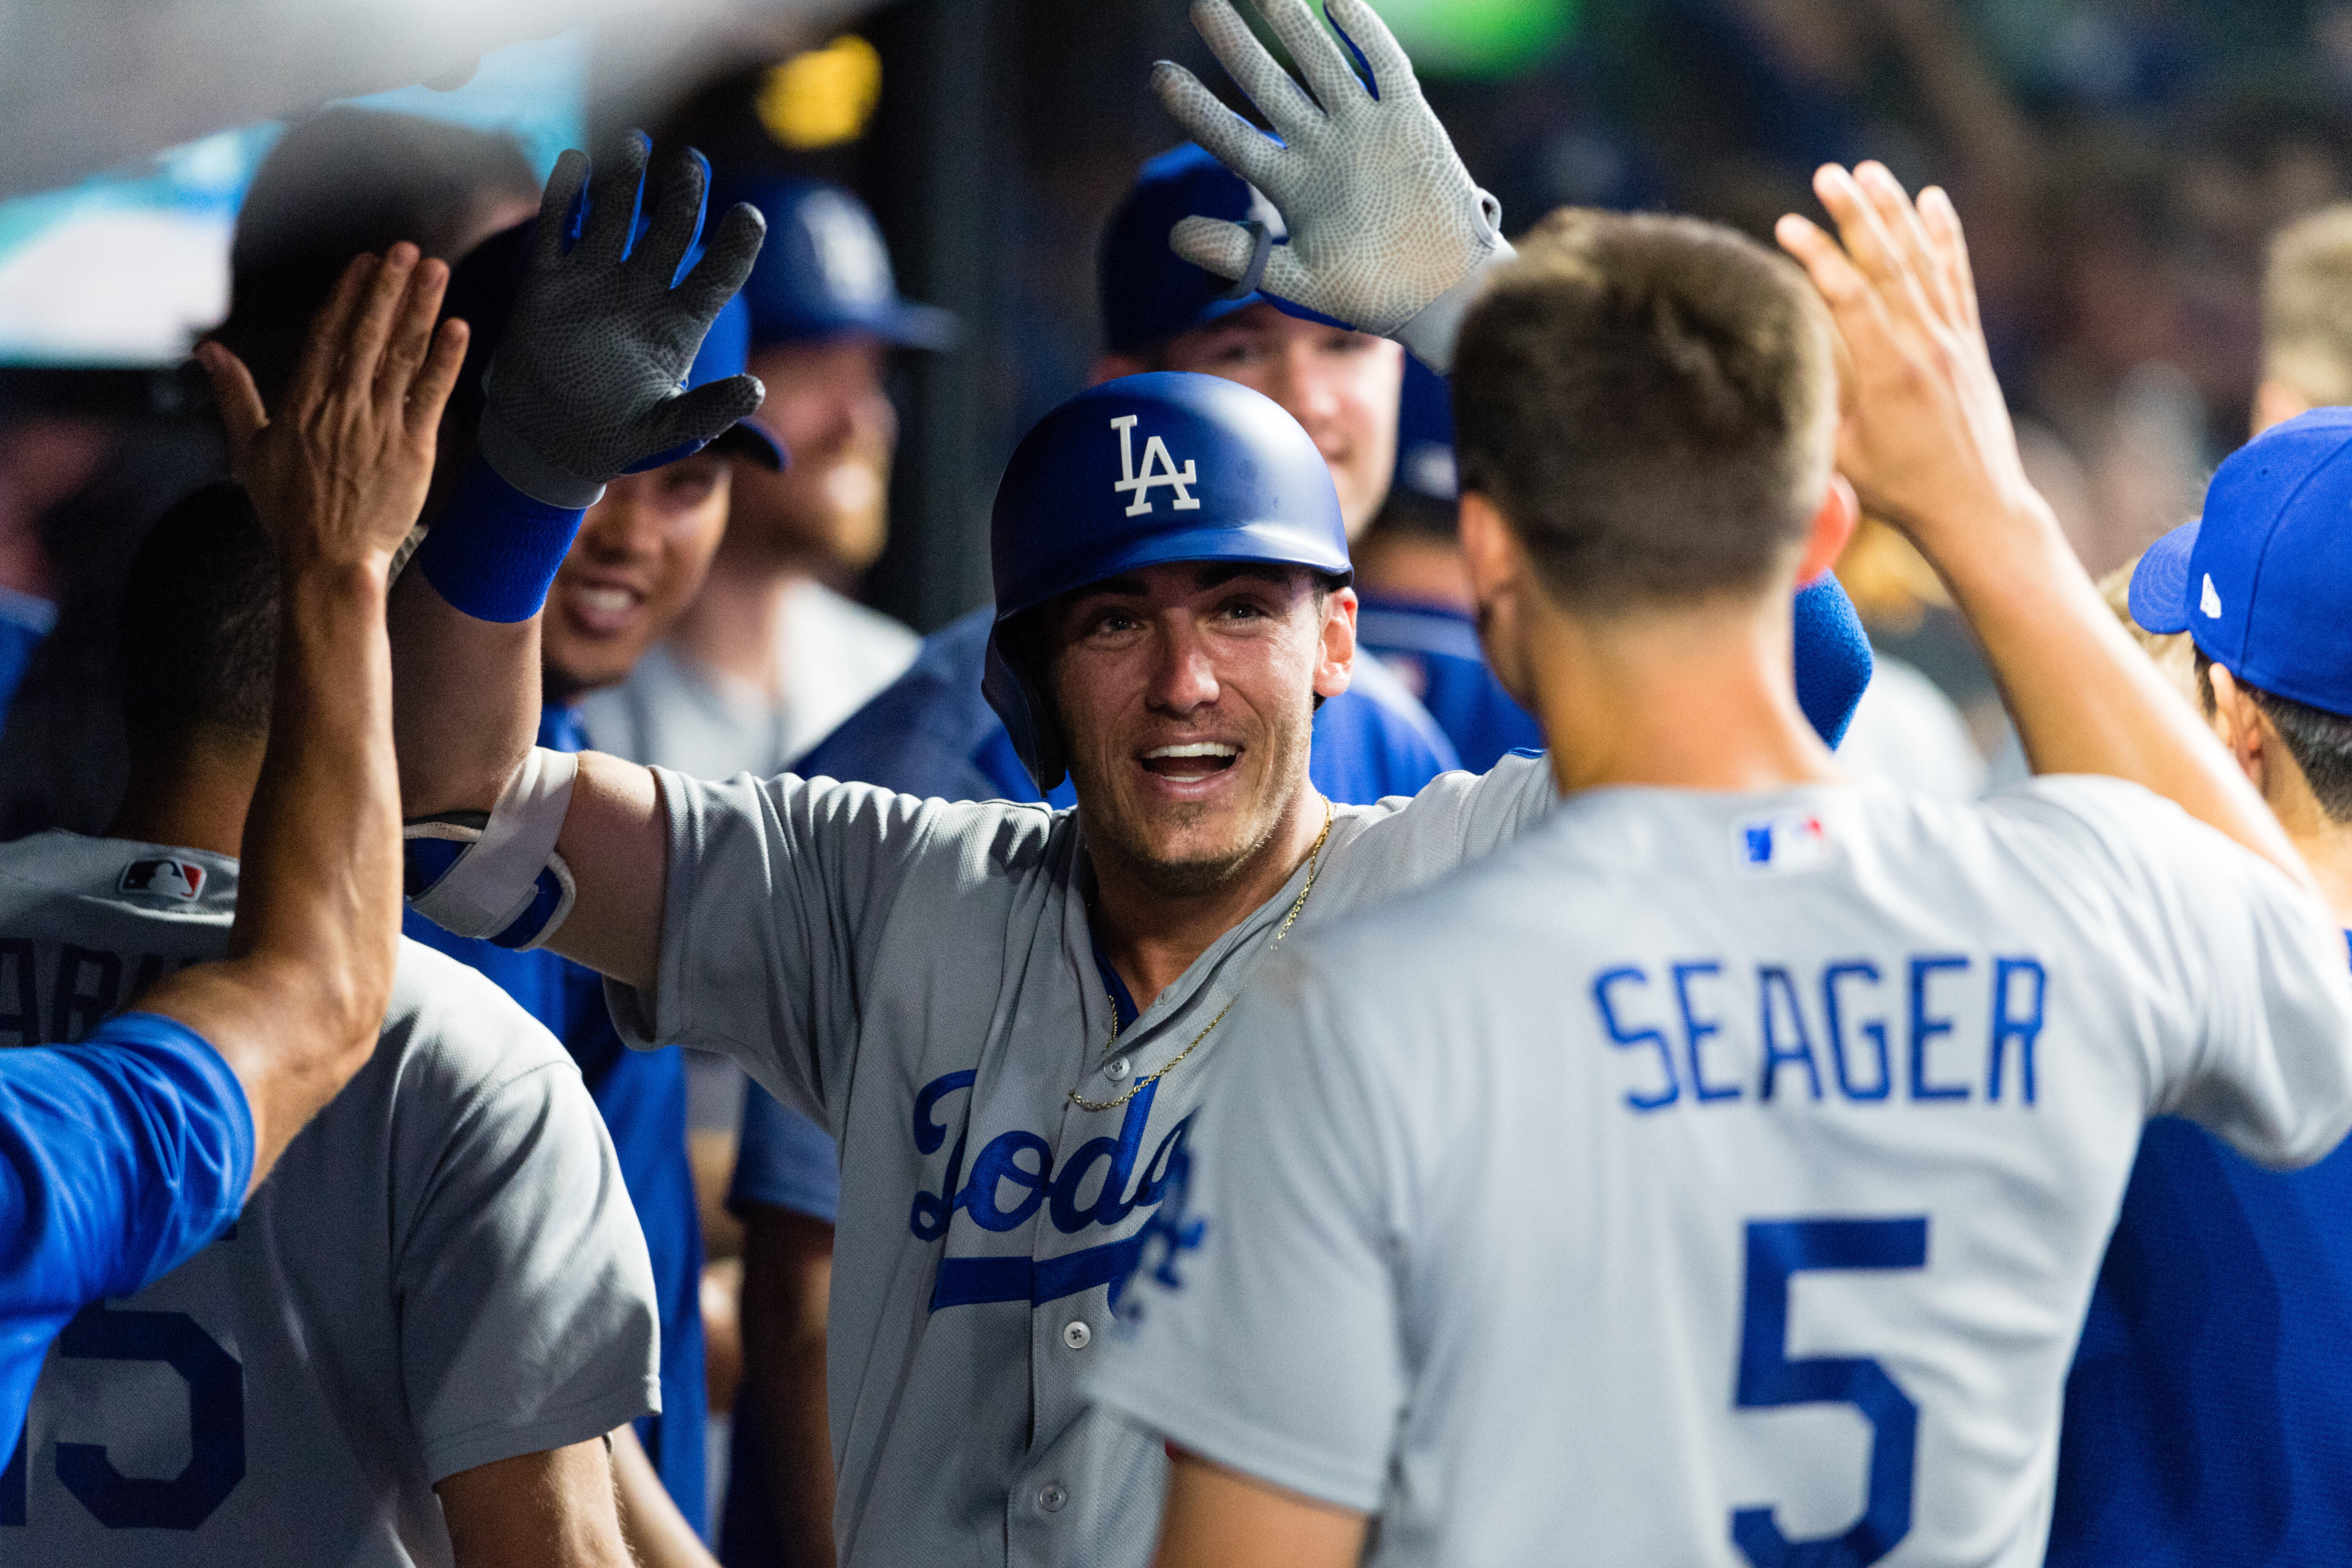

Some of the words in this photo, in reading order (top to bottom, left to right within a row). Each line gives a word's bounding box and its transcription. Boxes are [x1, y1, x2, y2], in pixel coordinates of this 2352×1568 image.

[1111, 414, 1200, 517] LA
[1588, 953, 2049, 1114] SEAGER
[1729, 1212, 1932, 1568] 5
